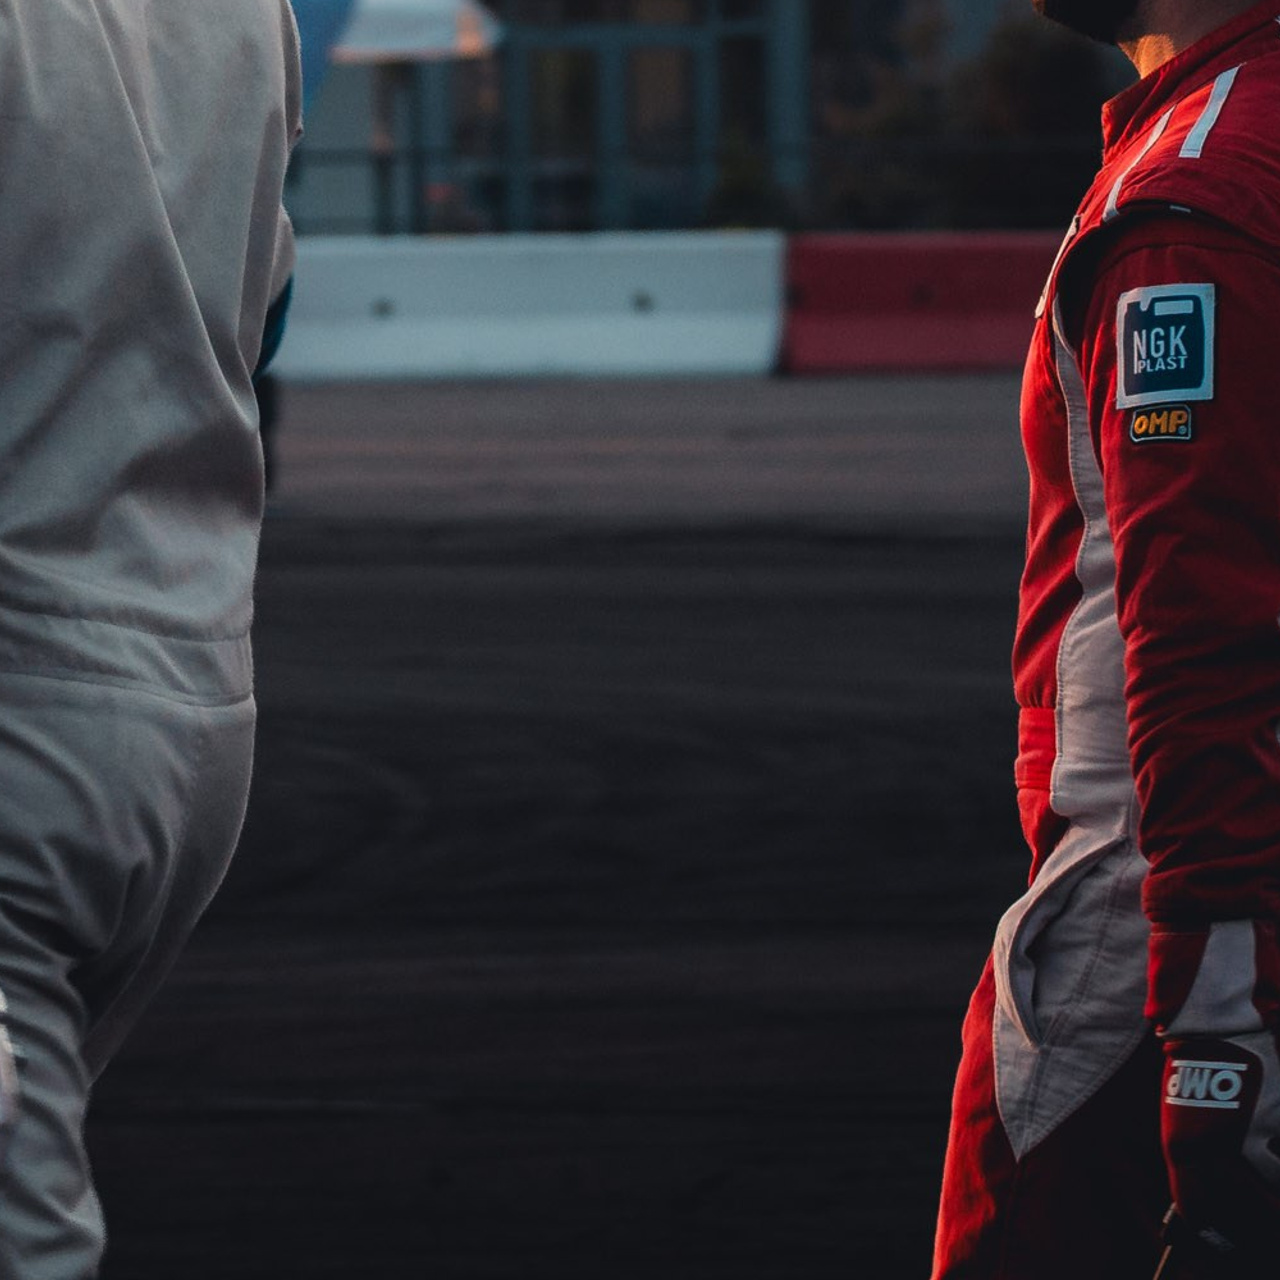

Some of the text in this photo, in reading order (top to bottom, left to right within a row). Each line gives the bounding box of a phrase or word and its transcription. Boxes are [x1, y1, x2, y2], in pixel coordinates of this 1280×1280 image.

[1133, 325, 1188, 365] NGK
[1137, 355, 1188, 374] PLAST
[1133, 410, 1188, 435] OMP
[1167, 1068, 1242, 1101] OMP
